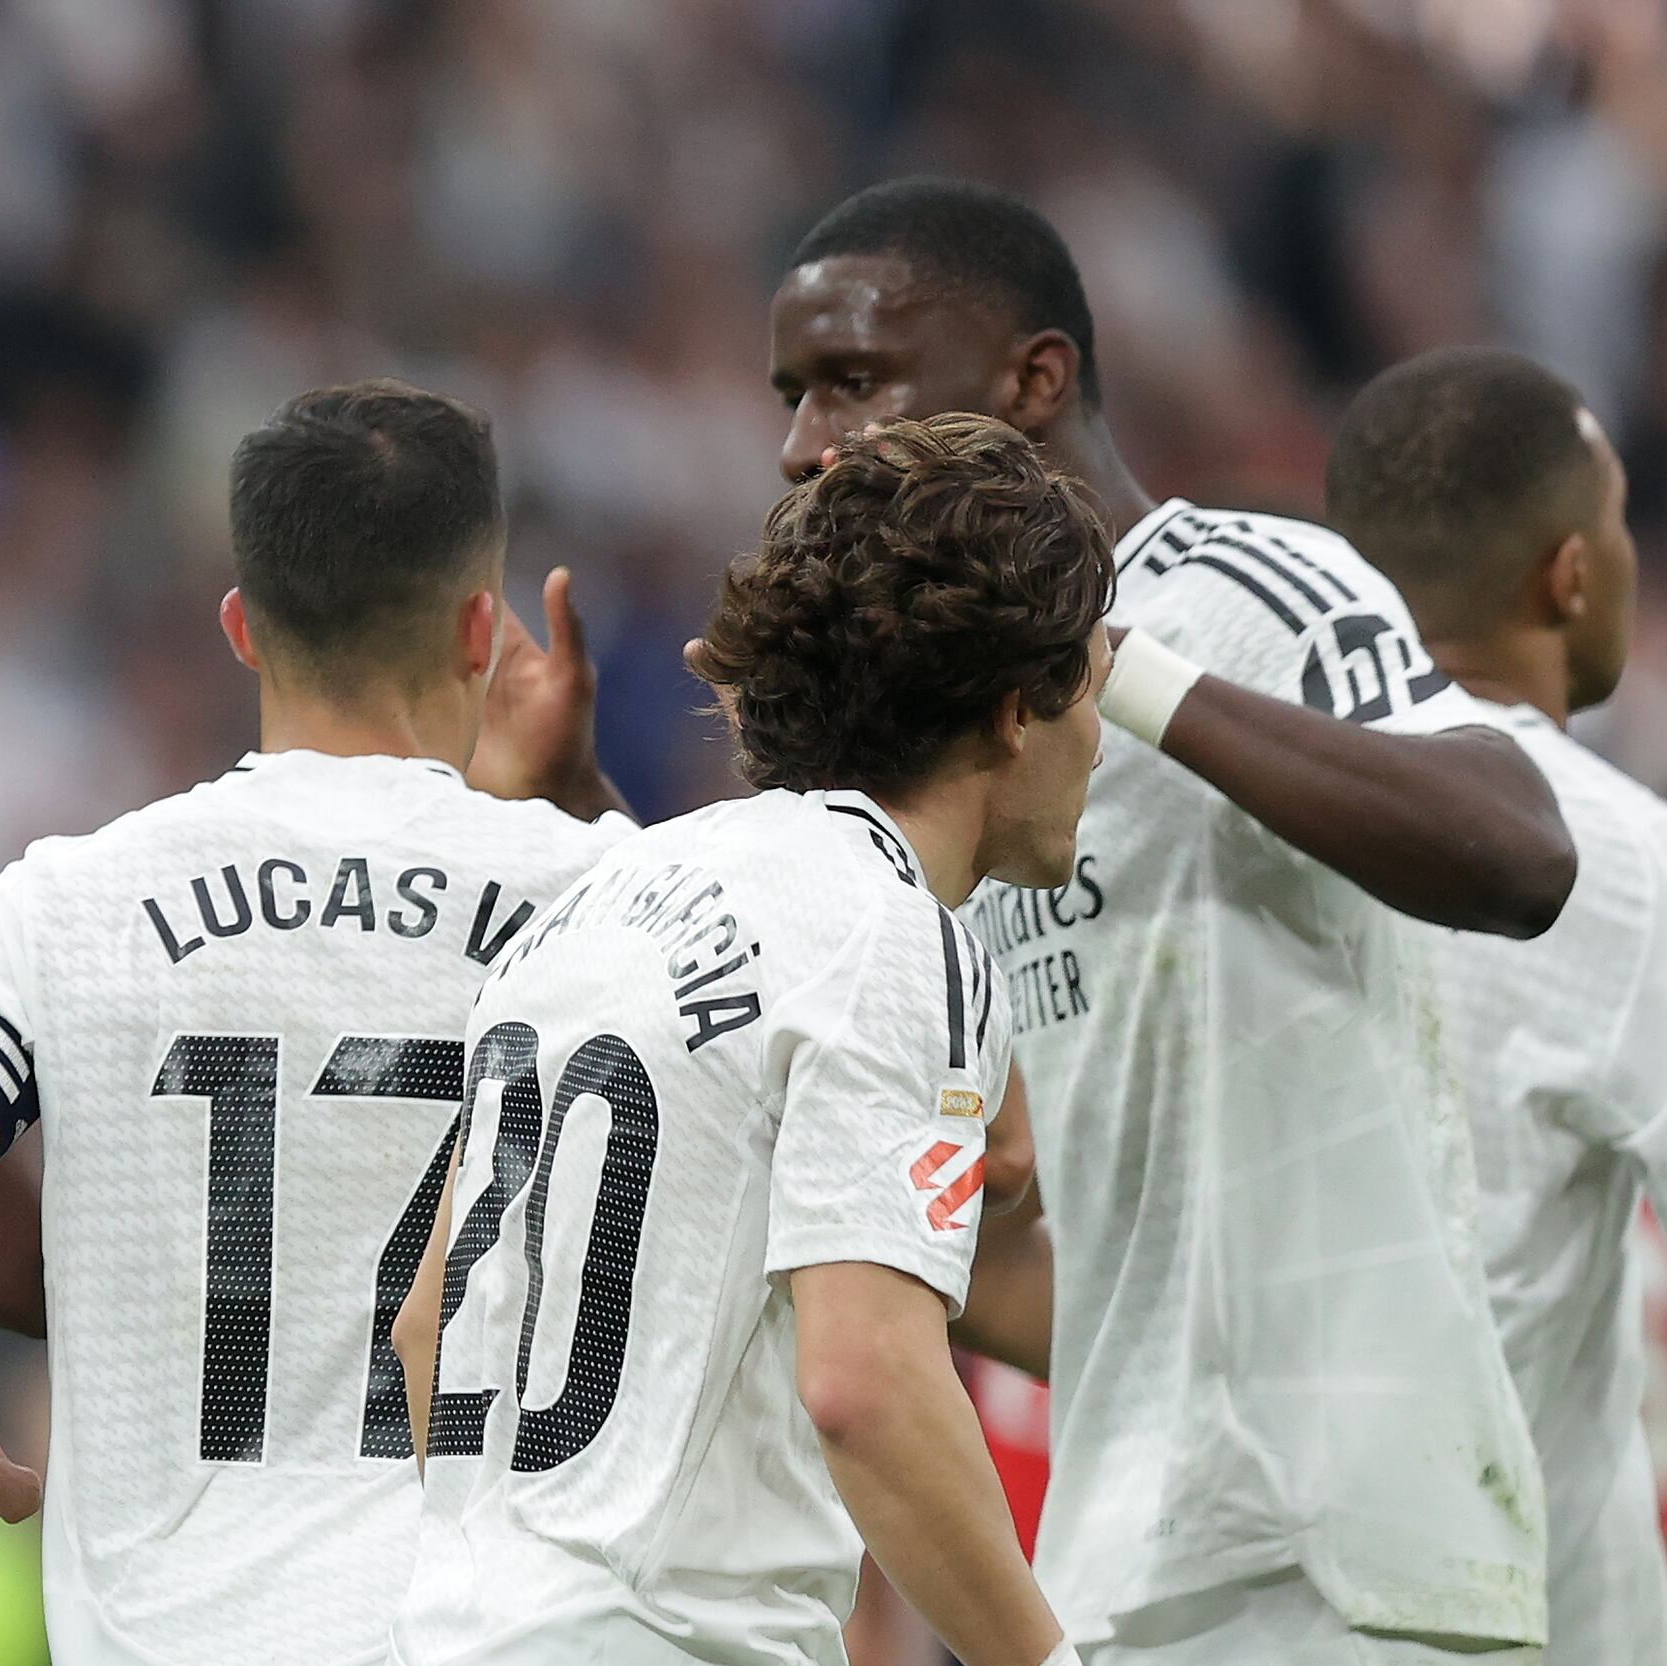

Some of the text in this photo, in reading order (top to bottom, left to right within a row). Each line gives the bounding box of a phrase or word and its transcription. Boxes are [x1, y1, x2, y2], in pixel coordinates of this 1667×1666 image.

[141, 857, 536, 966] LUCAS V
[150, 1034, 465, 1464] 17
[424, 1021, 659, 1473] 20
